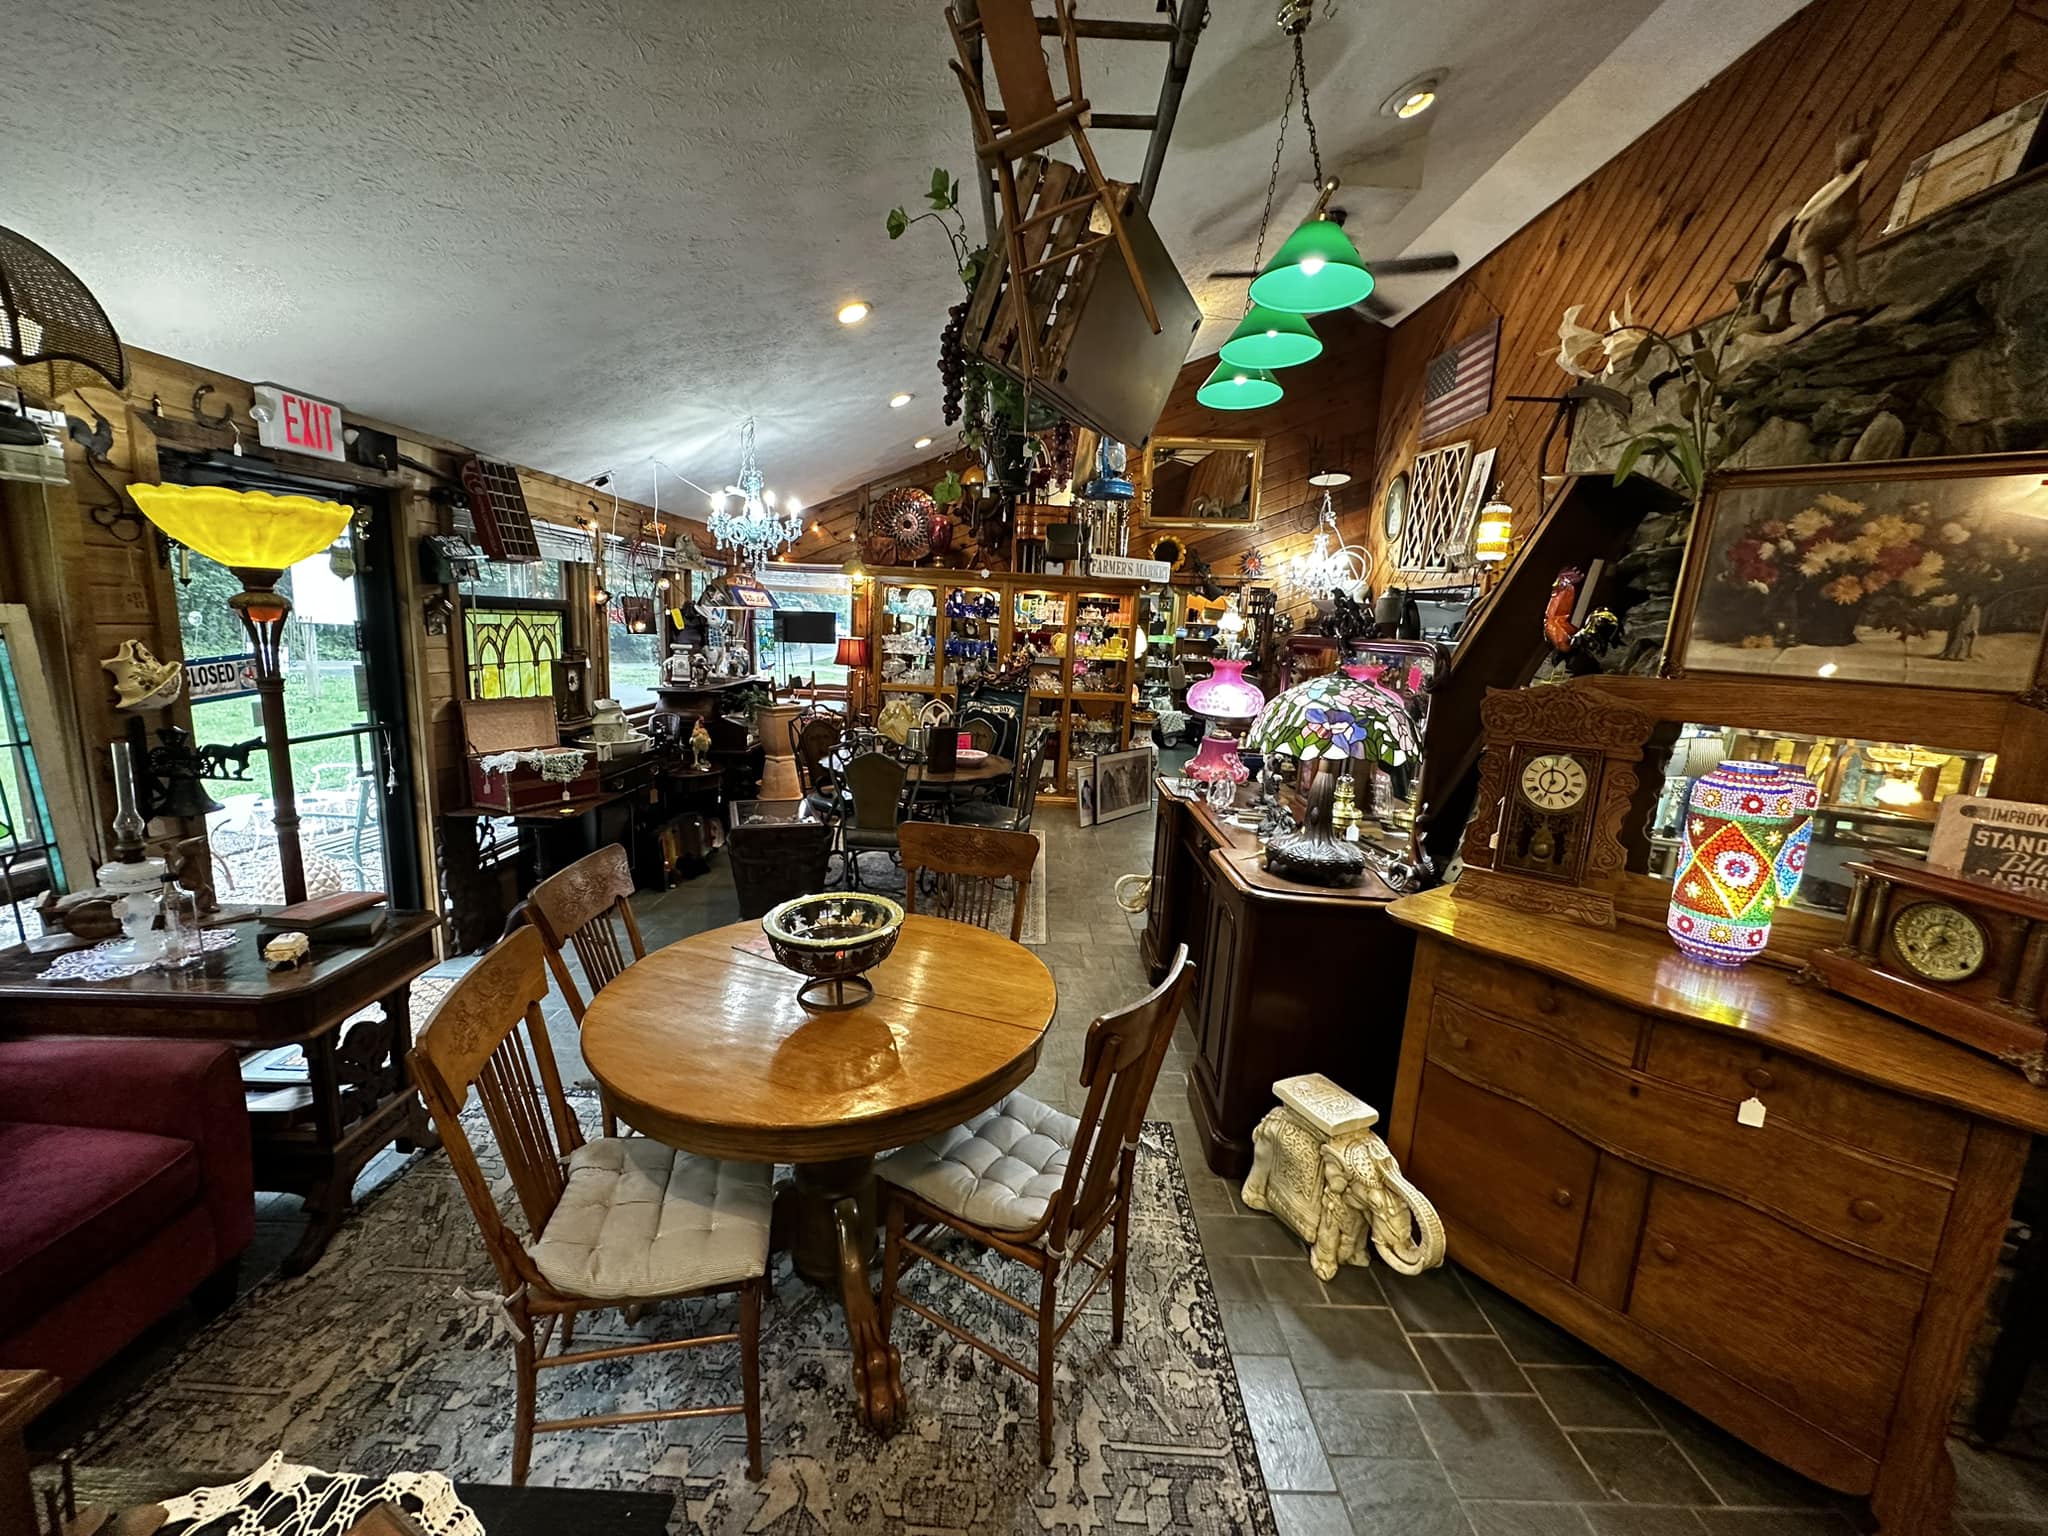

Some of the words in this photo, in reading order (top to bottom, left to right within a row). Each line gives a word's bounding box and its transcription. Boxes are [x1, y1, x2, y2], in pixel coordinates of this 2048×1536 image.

[282, 393, 333, 453] EXIT
[1091, 559, 1133, 577] FARMER'S
[1135, 562, 1170, 579] MARKET
